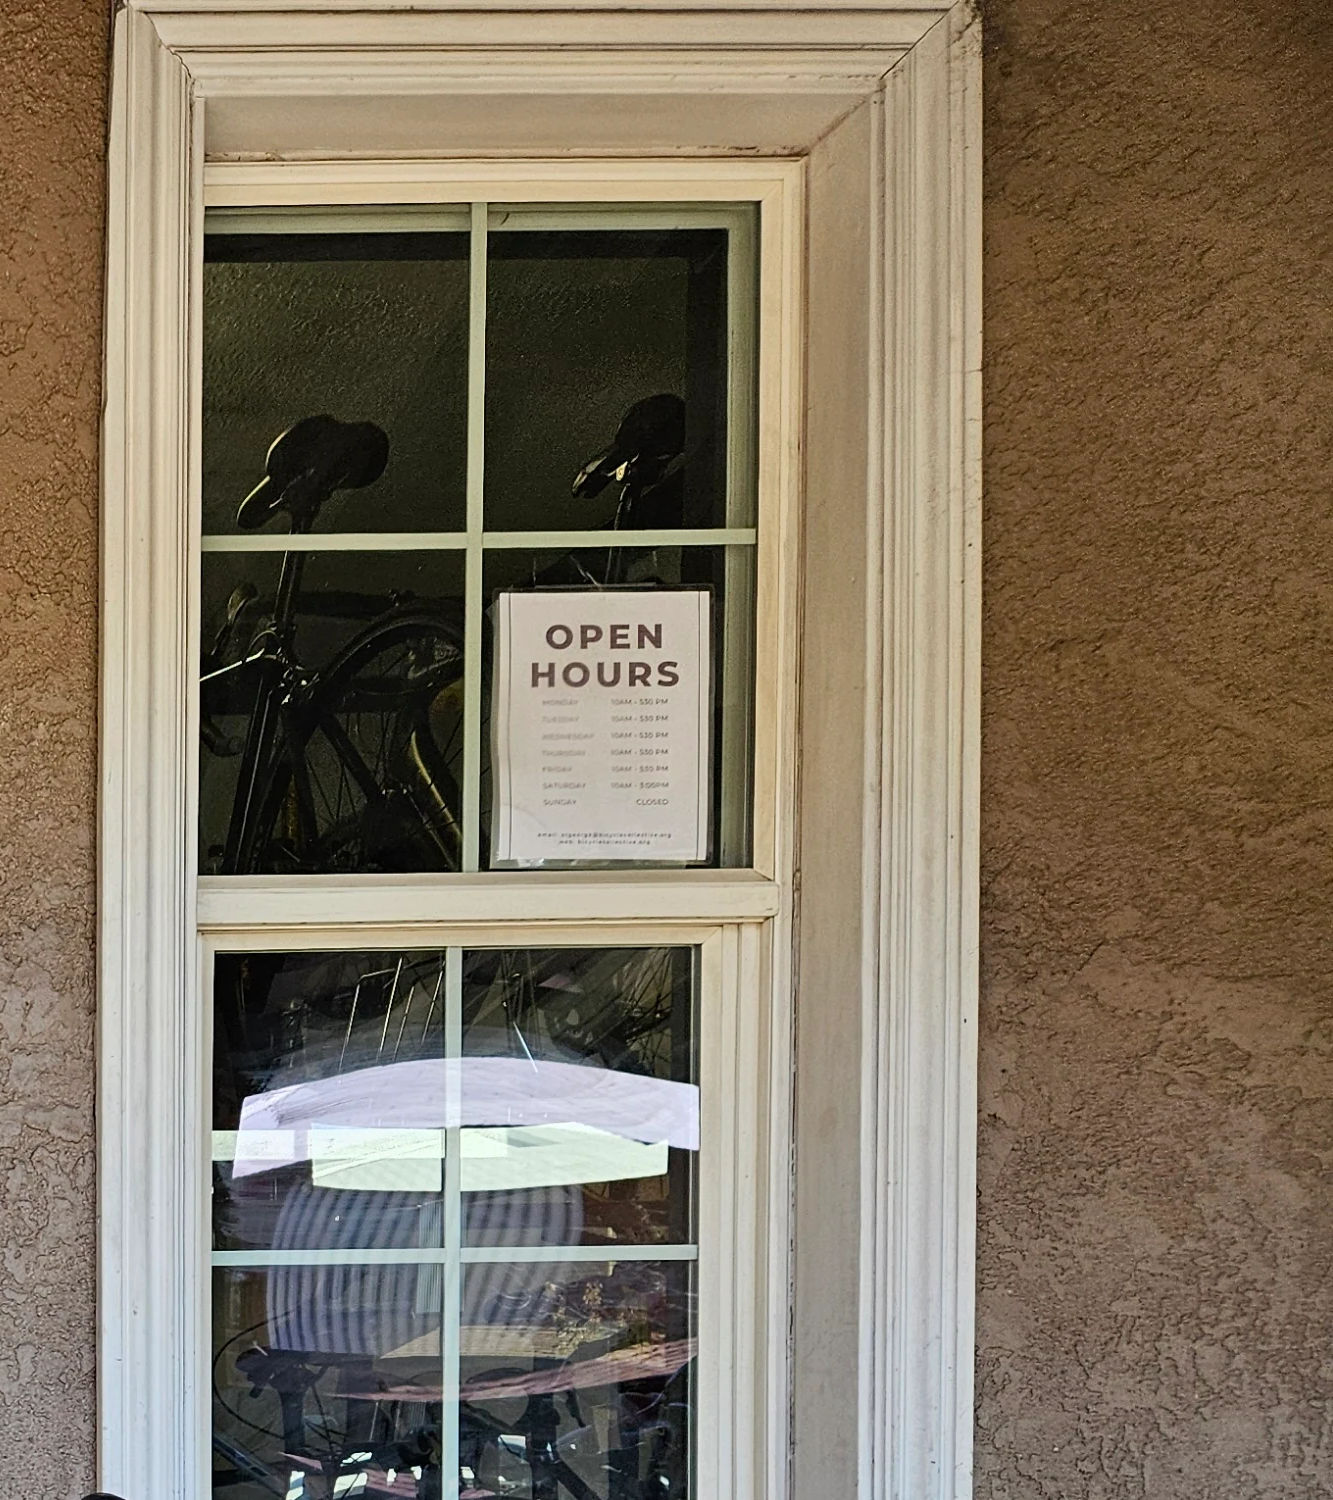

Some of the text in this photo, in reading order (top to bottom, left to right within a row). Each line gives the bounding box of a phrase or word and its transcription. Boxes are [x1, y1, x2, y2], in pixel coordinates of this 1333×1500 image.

[545, 623, 662, 650] OPEN
[531, 660, 680, 688] HOURS
[635, 798, 669, 806] CLOSED
